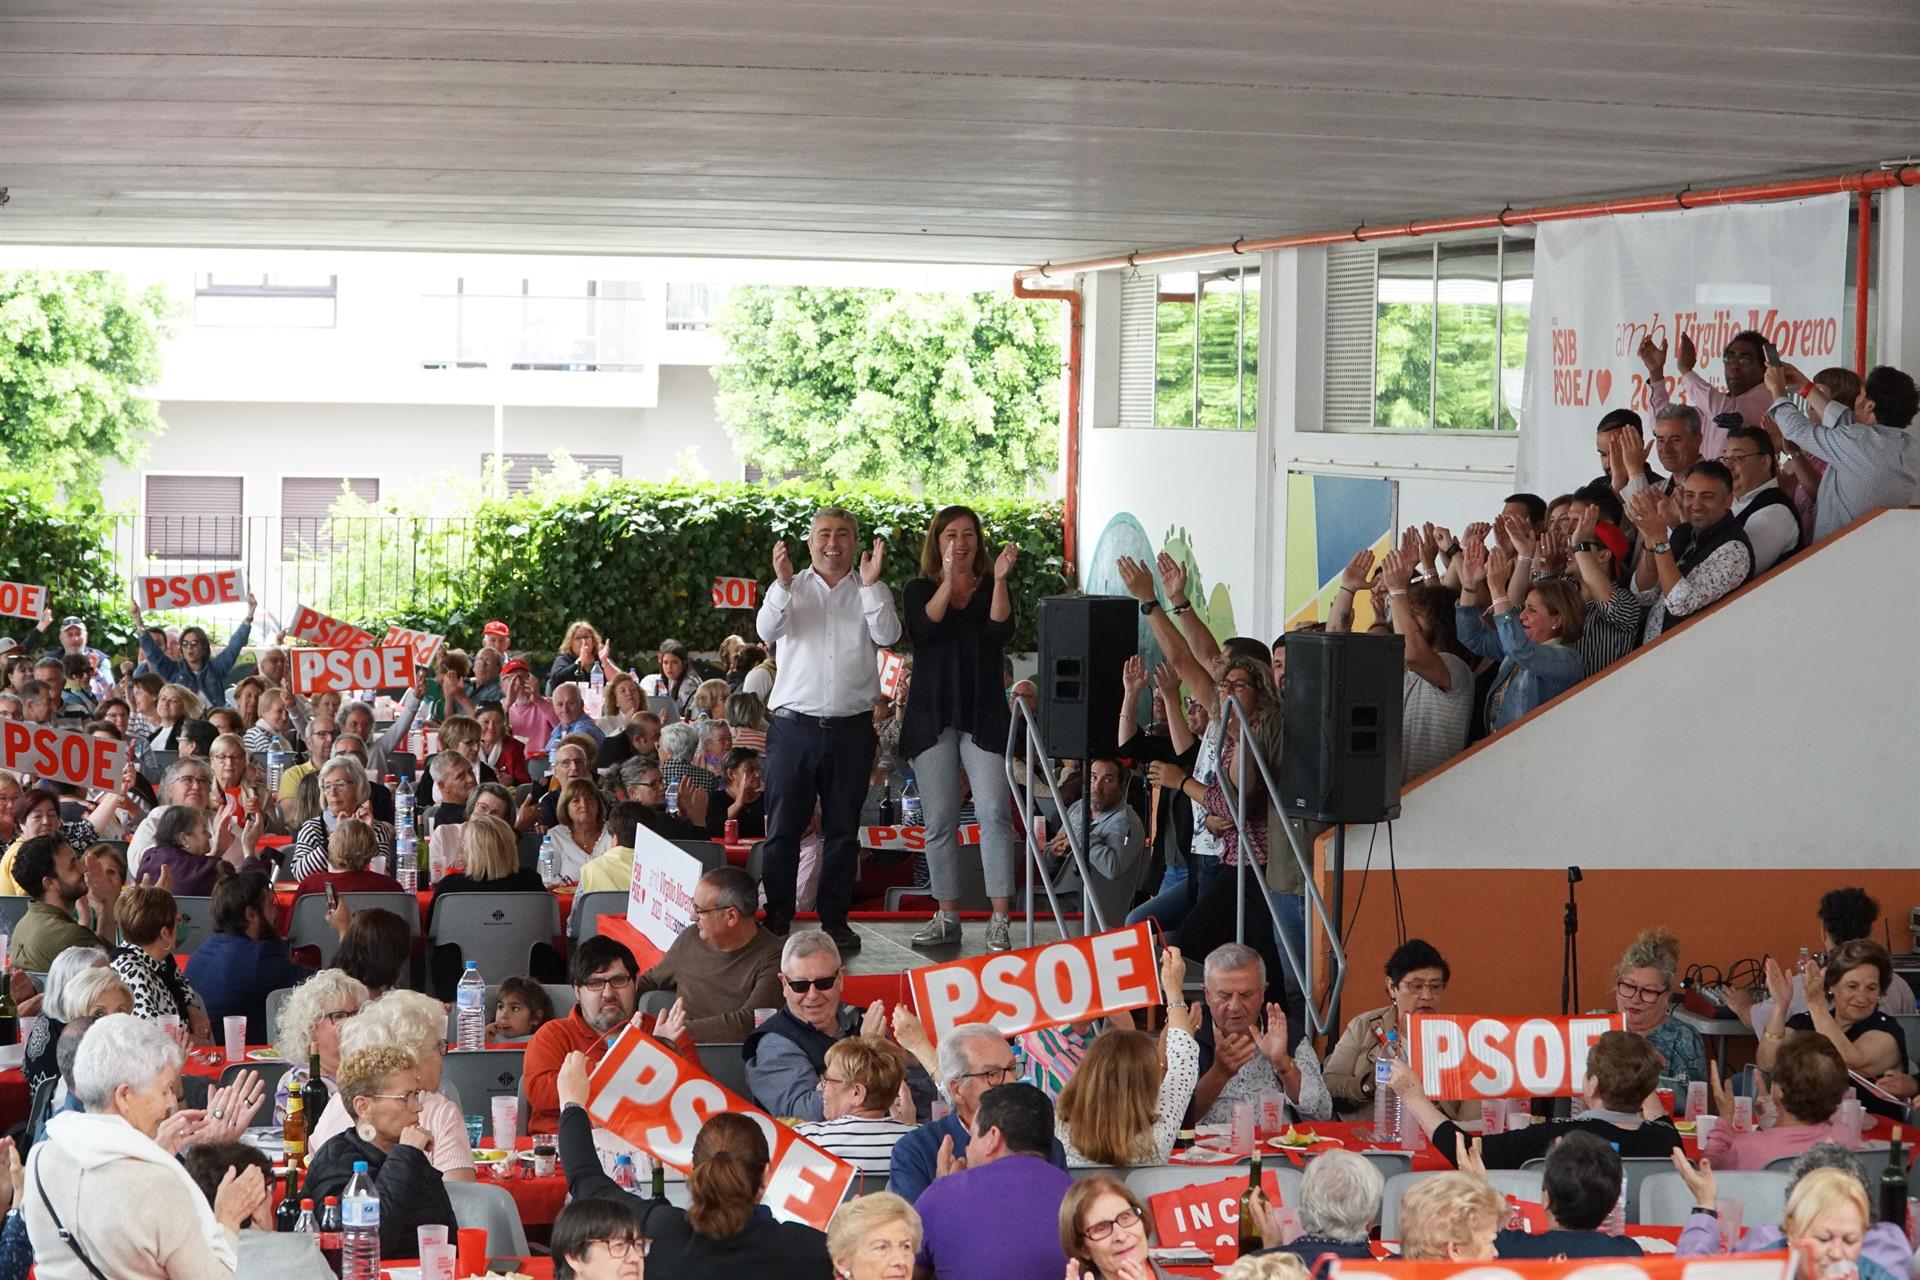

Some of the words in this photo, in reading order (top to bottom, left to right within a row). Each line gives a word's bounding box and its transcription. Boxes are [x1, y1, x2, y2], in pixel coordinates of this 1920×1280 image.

[1552, 329, 1577, 366] PSIB
[1748, 309, 1837, 357] Moreno
[144, 571, 241, 609] PSOE
[292, 607, 376, 648] PSOE
[299, 646, 410, 692] PSOE
[4, 721, 117, 790] PSOE
[924, 928, 1149, 1047] PSOE
[1420, 1018, 1611, 1096] PSOE
